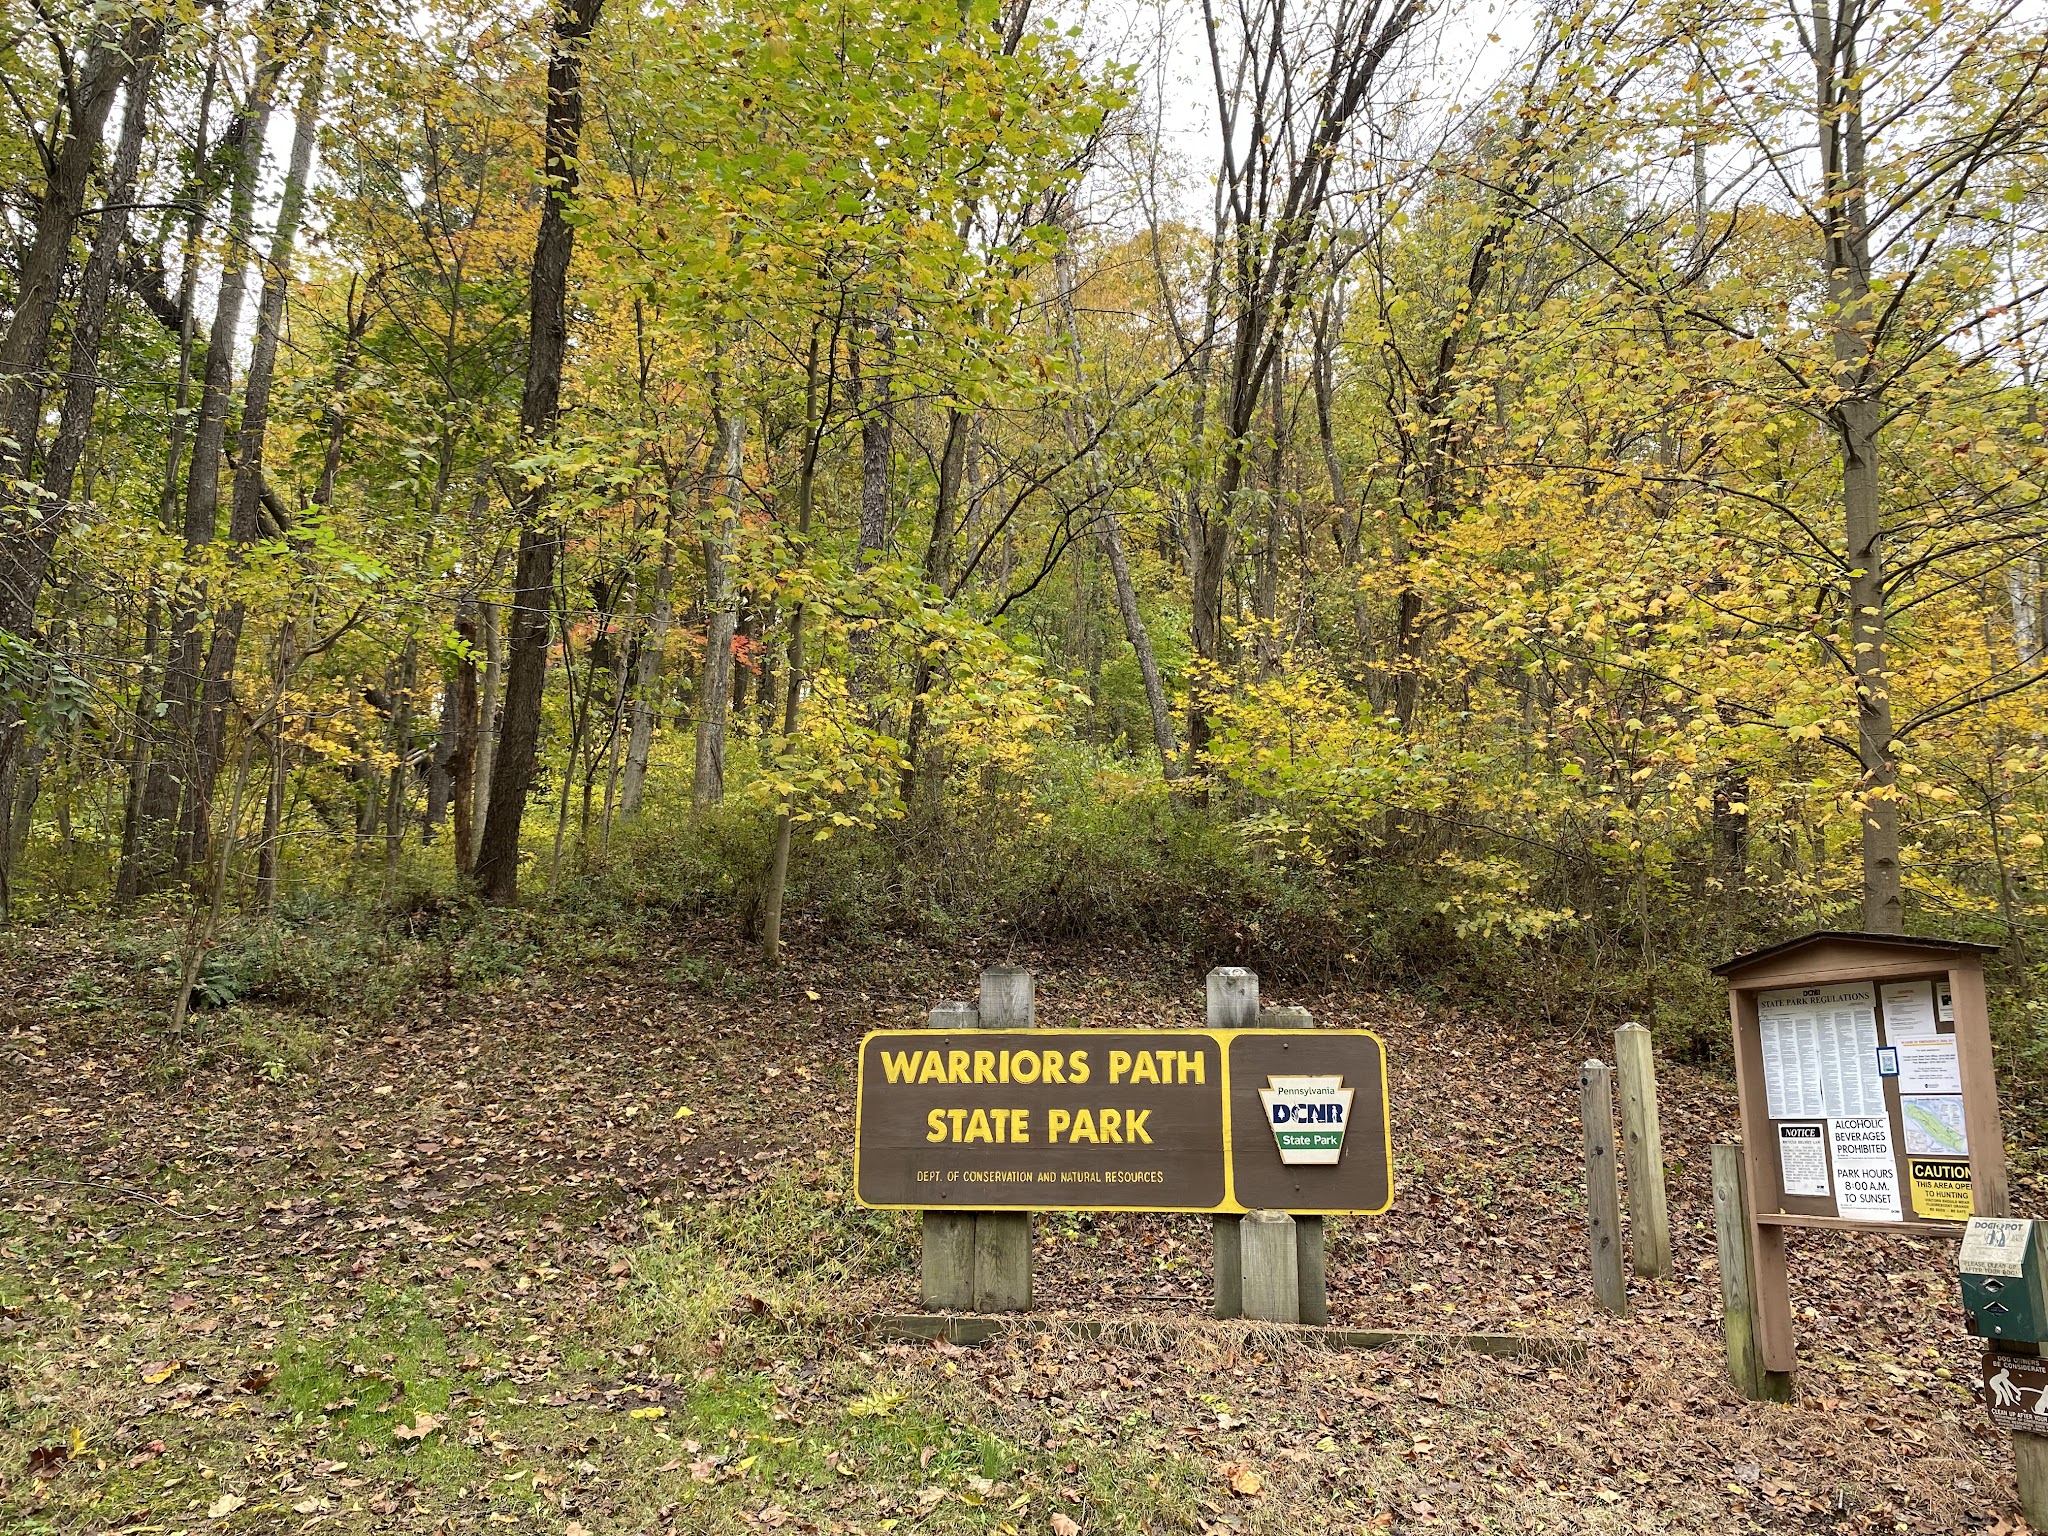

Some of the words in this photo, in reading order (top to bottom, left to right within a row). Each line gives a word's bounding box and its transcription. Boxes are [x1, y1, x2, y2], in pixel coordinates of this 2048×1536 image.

[1761, 1000, 1785, 1008] STATE
[1786, 998, 1808, 1006] PARK
[1810, 992, 1870, 1004] REGULATIONS
[880, 1050, 1091, 1084] WARRIORS
[1109, 1050, 1205, 1084] PATH
[1278, 1087, 1335, 1096] Pennsylvania
[1272, 1104, 1343, 1123] DCNR
[926, 1108, 1030, 1143] STATE
[1048, 1108, 1154, 1144] PARK
[1835, 1120, 1884, 1129] ALCOHOLIC
[1785, 1128, 1816, 1137] NOTICE
[1835, 1132, 1886, 1141] BEVERAGES
[1283, 1135, 1310, 1145] State
[1314, 1135, 1338, 1145] Park
[1837, 1144, 1886, 1153] PROHIBITED
[1838, 1169, 1860, 1178] PARK
[1862, 1169, 1893, 1178] HOURS
[1914, 1164, 1971, 1178] CAUTION
[917, 1171, 943, 1182] DEPT.
[947, 1171, 959, 1182] OF
[963, 1171, 1033, 1182] CONSERVATION
[1038, 1172, 1056, 1182] AND
[1061, 1172, 1101, 1182] NATURAL
[1105, 1172, 1164, 1183] RESOURCES
[1845, 1182, 1868, 1190] 8:00
[1870, 1182, 1889, 1190] A.M.
[1845, 1194, 1856, 1202] TO
[1860, 1194, 1891, 1203] SUNSET
[2004, 1362, 2046, 1374] CONSIDERATE
[1991, 1408, 2008, 1416] CLEAN
